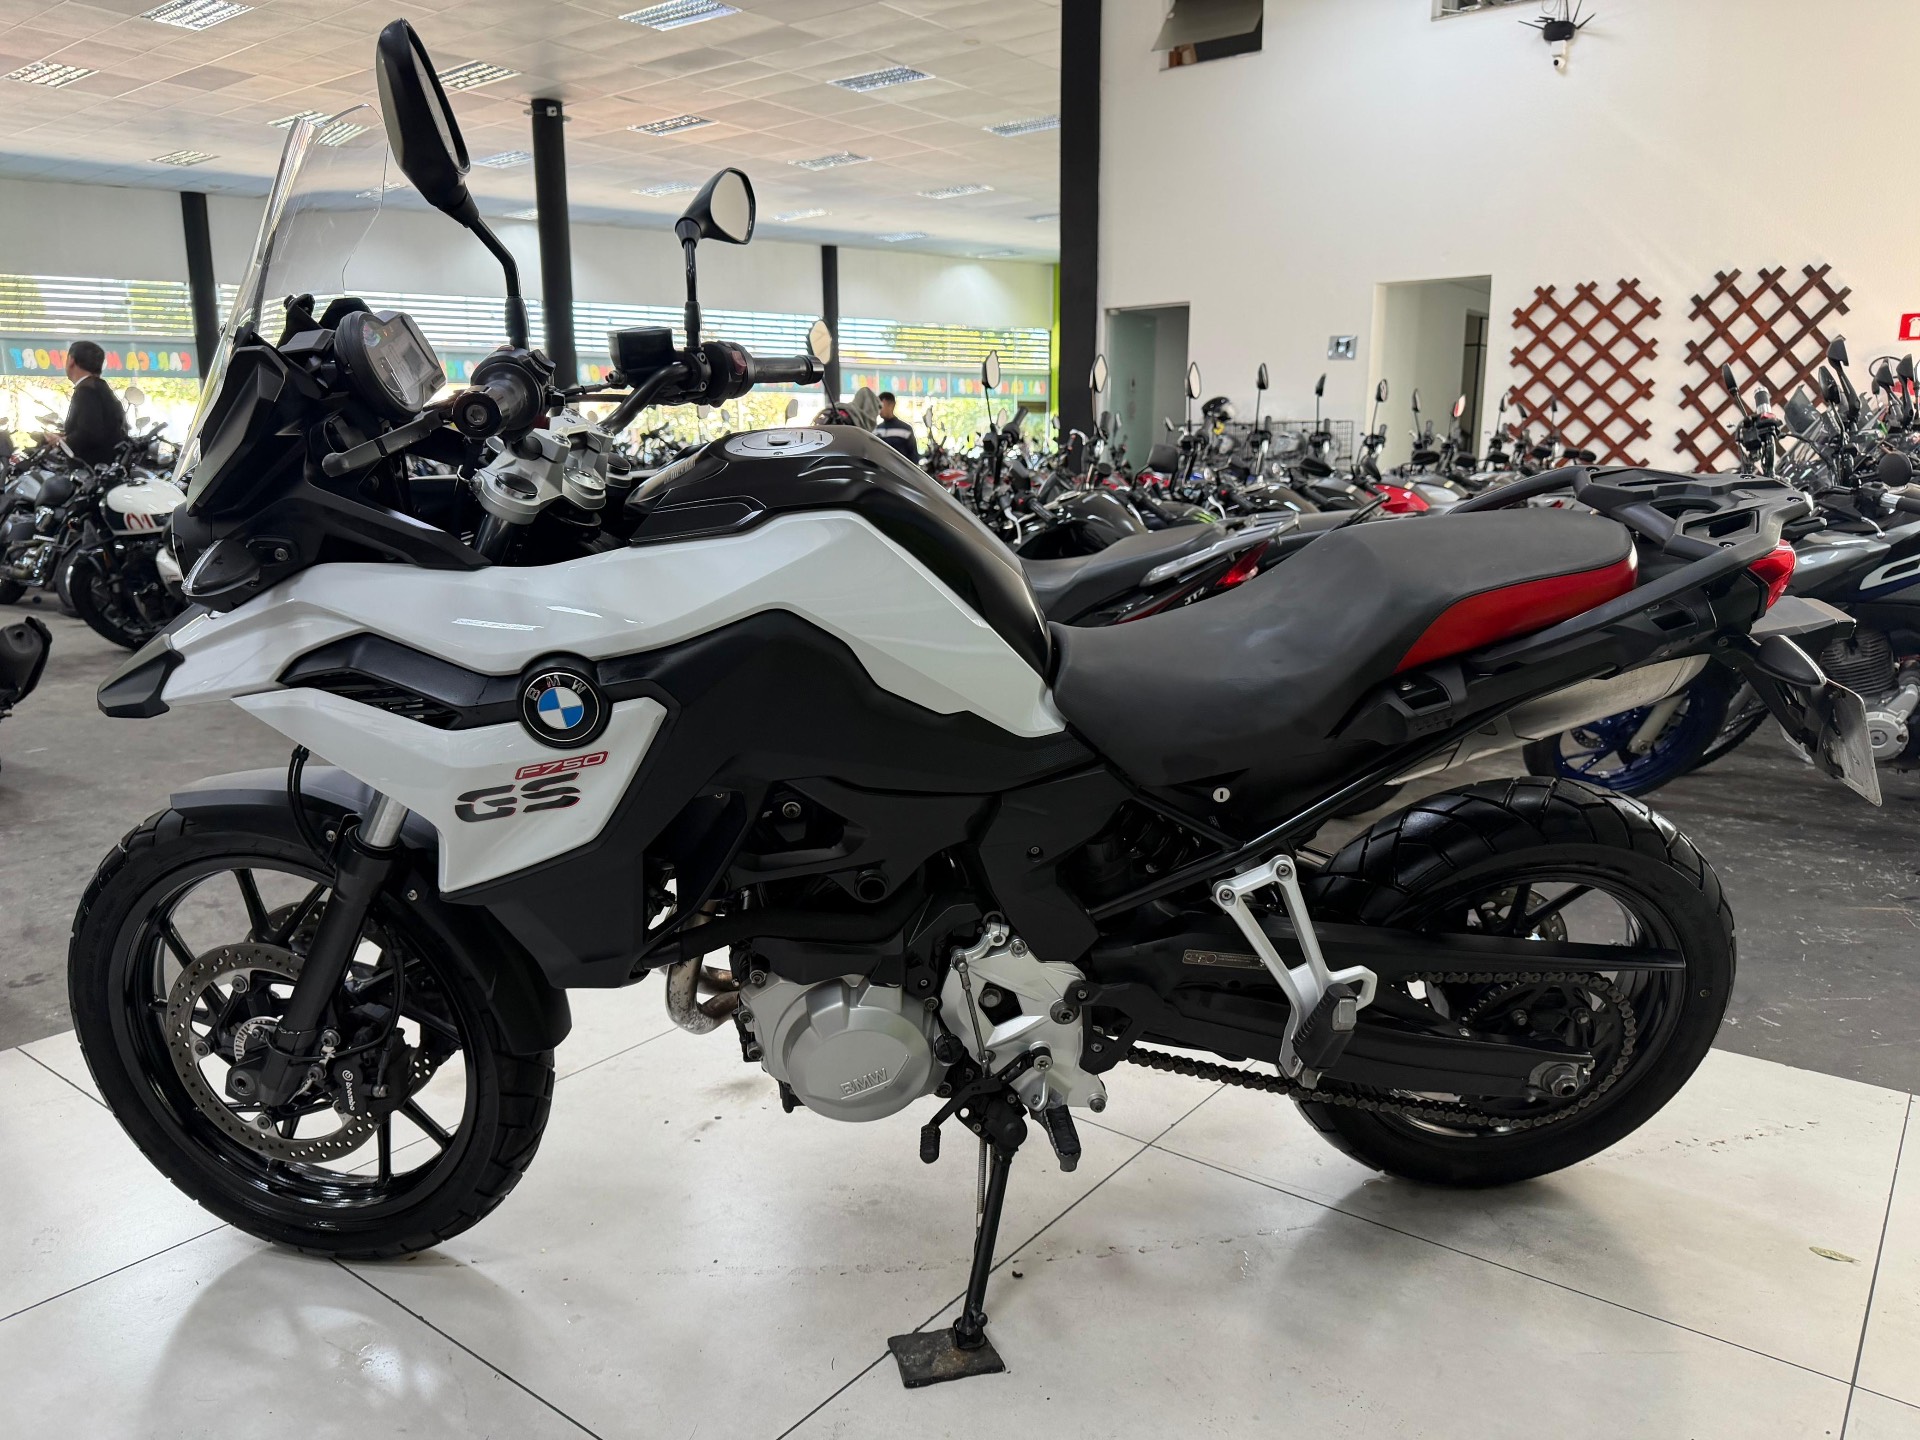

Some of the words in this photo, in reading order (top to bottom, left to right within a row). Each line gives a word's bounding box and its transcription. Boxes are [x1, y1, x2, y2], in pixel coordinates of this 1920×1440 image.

[526, 674, 588, 702] BMW
[518, 753, 606, 779] F750
[454, 772, 581, 823] GS
[840, 1068, 889, 1095] BMW
